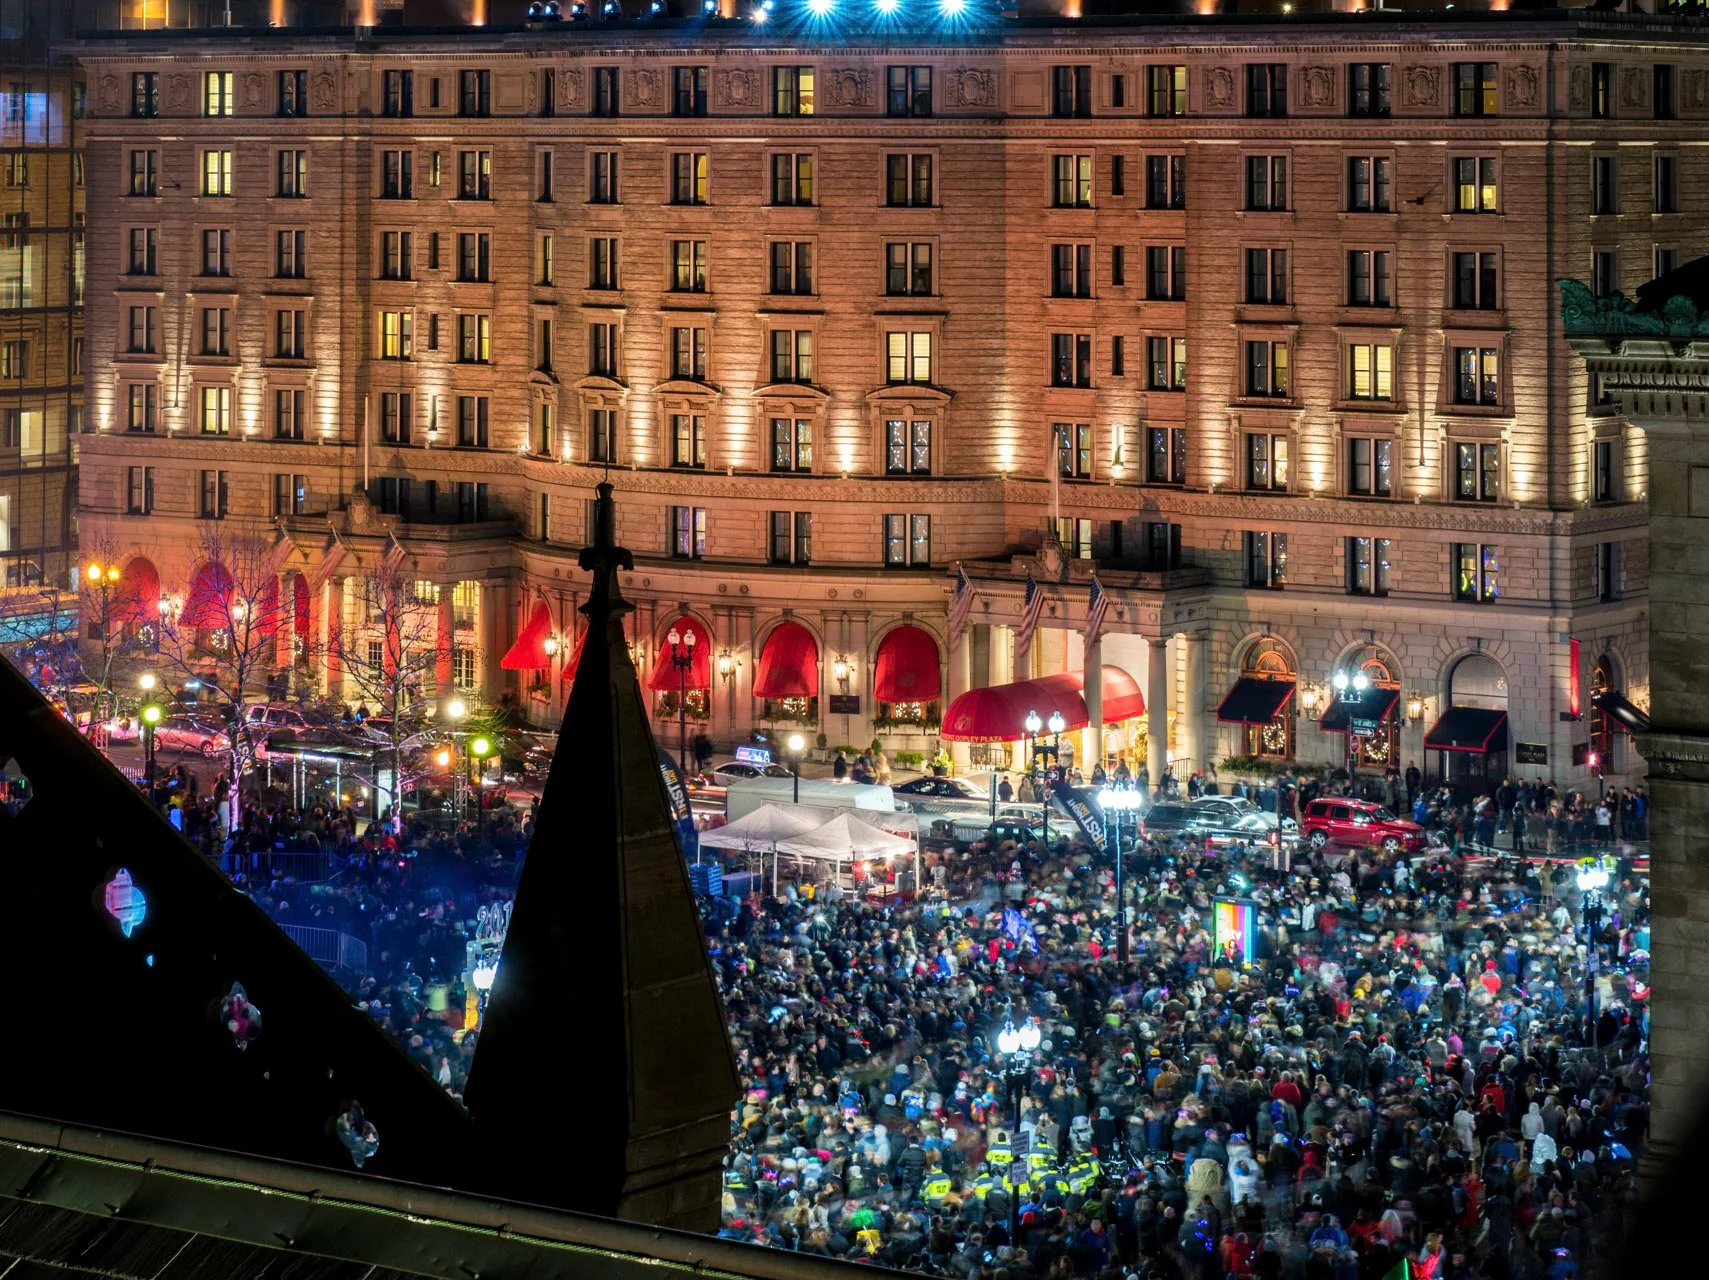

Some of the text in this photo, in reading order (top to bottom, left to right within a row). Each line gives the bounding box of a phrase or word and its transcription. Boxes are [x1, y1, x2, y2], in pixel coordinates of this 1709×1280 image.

[955, 734, 978, 743] COPLEY
[667, 769, 678, 783] DAY
[667, 784, 689, 820] FIRST
[1077, 802, 1090, 816] DAY
[1067, 798, 1108, 852] FIRST NIGHT
[476, 900, 513, 940] 201
